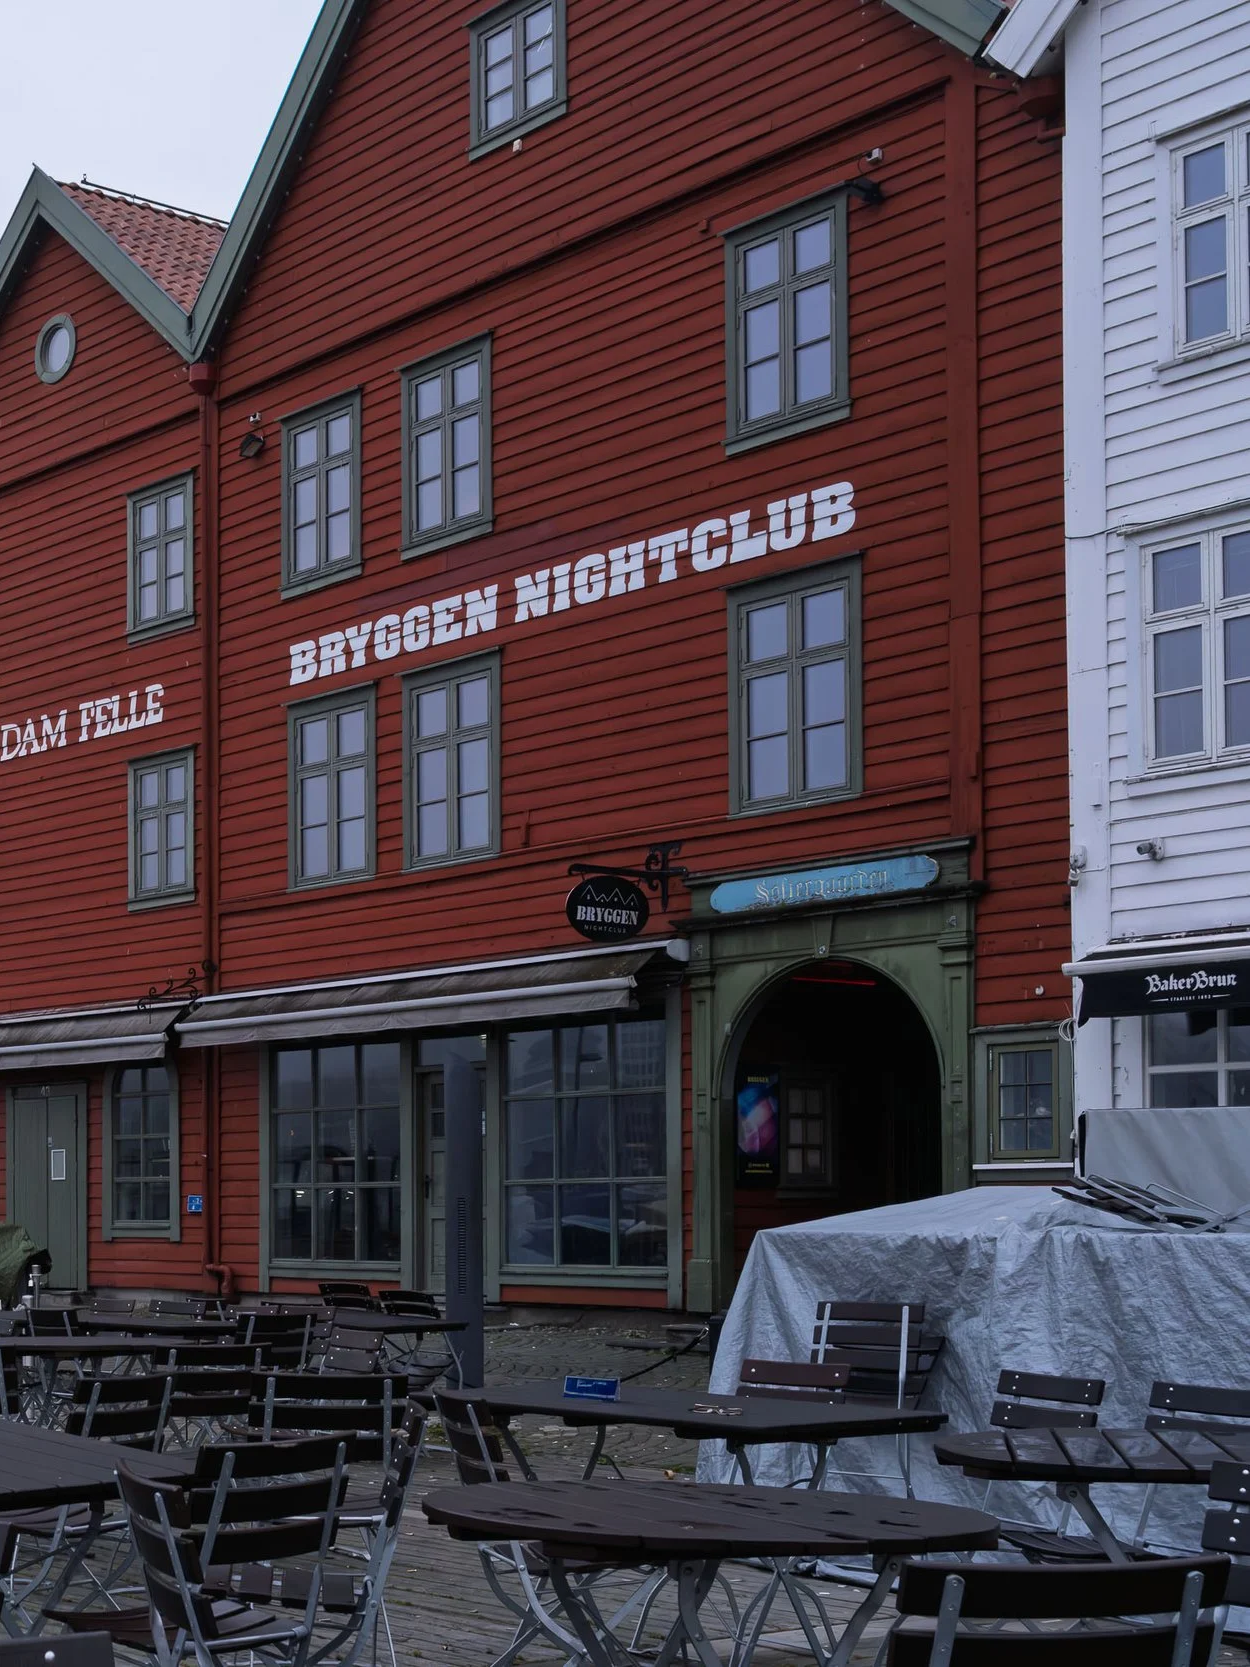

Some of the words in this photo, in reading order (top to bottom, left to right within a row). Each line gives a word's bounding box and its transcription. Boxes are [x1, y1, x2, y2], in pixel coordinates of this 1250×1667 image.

[289, 585, 499, 686] BRYGGEN
[514, 481, 856, 624] NIGHTCLUB
[78, 683, 165, 742] FELLE
[576, 905, 638, 925] BRYGGEN
[584, 924, 626, 934] NIGHTCLUB
[1145, 970, 1237, 995] BakerBrun
